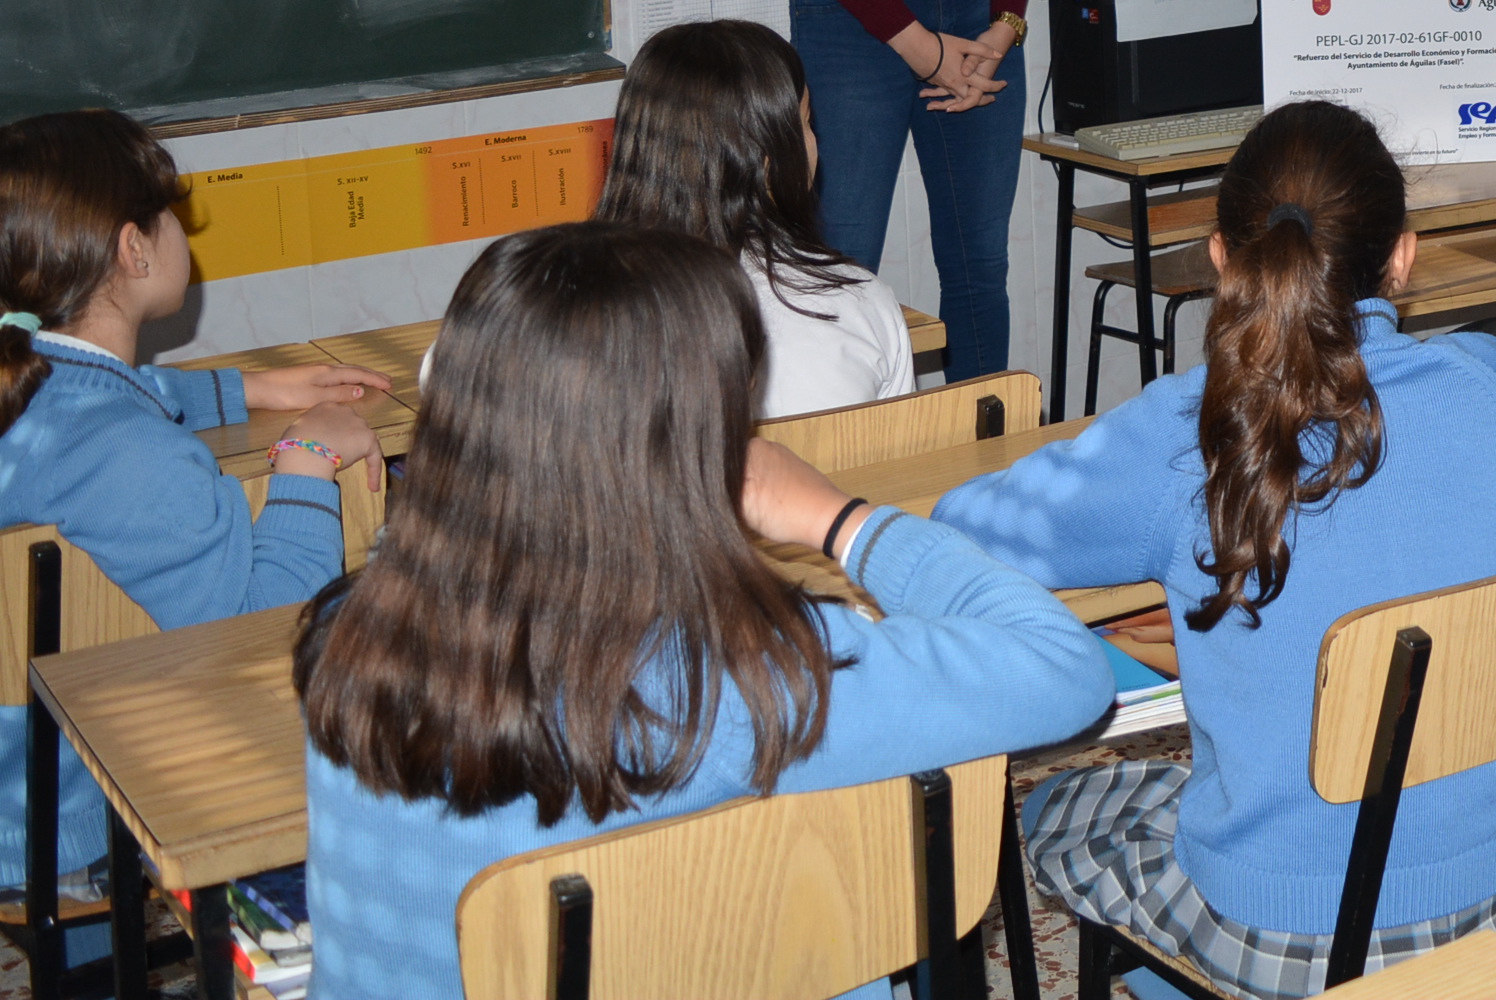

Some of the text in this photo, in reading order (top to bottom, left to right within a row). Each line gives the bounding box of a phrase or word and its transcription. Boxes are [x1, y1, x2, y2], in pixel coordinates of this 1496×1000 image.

[1316, 30, 1482, 47] PEPL-GJ 2017-02-61GF-0010
[1343, 52, 1372, 60] Servicio
[1373, 51, 1382, 59] de
[1383, 50, 1420, 58] Desarrollo
[1422, 48, 1460, 57] Económico
[1347, 61, 1398, 70] Ayuntamiento
[1409, 58, 1436, 68] Águilas
[577, 125, 594, 134] 1789
[485, 135, 527, 146] E. Moderna
[414, 146, 433, 156] 1492
[207, 172, 244, 184] E. Media
[337, 177, 345, 186] S.
[559, 167, 567, 206] Ilustración
[511, 179, 519, 209] Barroco
[460, 176, 469, 227] Renacimiento
[347, 190, 357, 228] Baja Edad
[357, 196, 365, 220] Media
